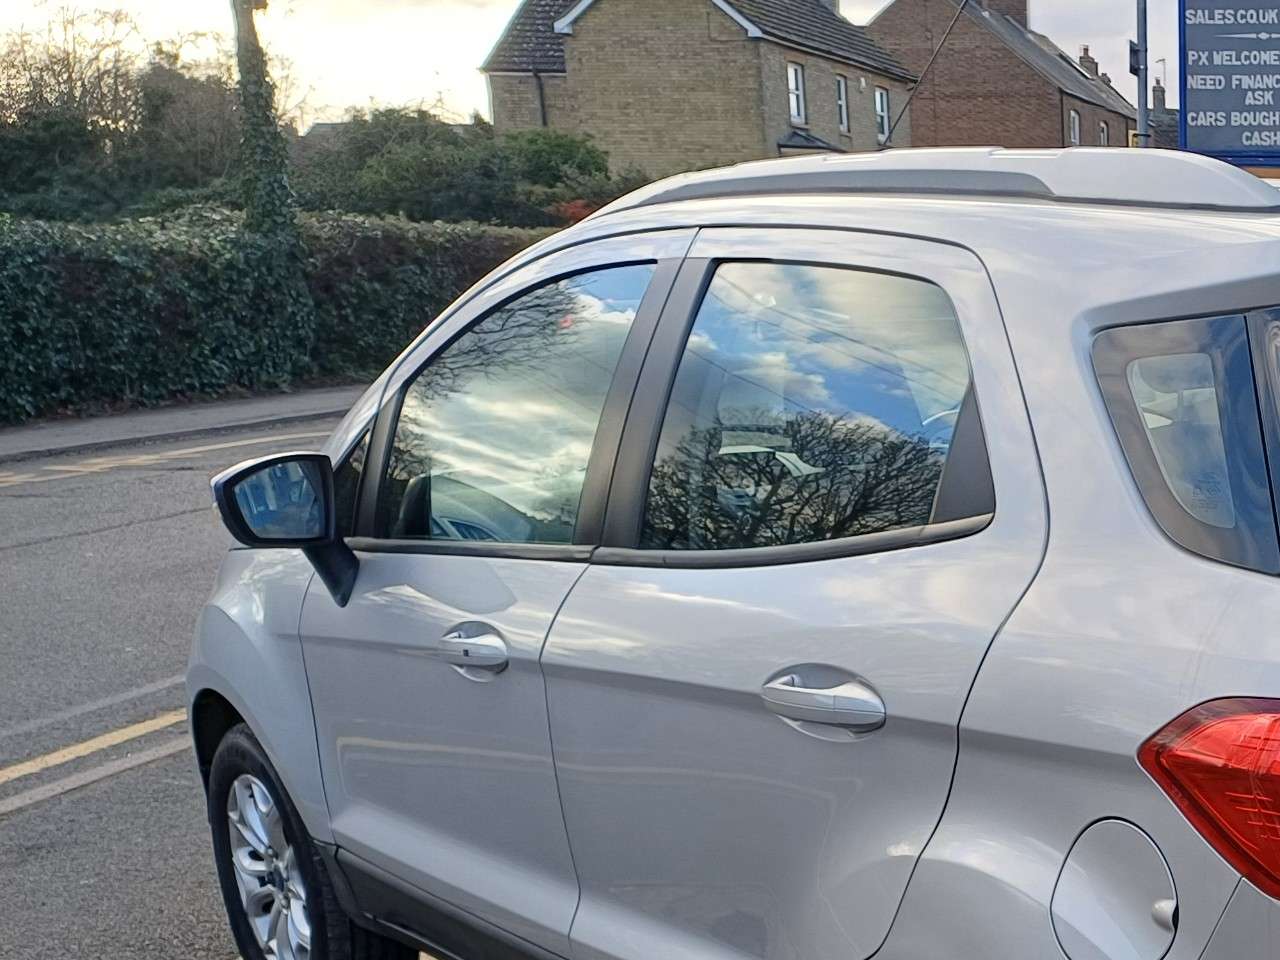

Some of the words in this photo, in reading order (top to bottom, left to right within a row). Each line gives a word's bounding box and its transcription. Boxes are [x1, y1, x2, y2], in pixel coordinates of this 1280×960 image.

[1188, 51, 1209, 65] PX
[1213, 51, 1280, 66] WELCOME
[1187, 74, 1225, 90] NEED
[1245, 91, 1274, 105] ASK
[1187, 111, 1226, 126] CARS
[1242, 131, 1280, 146] CASH
